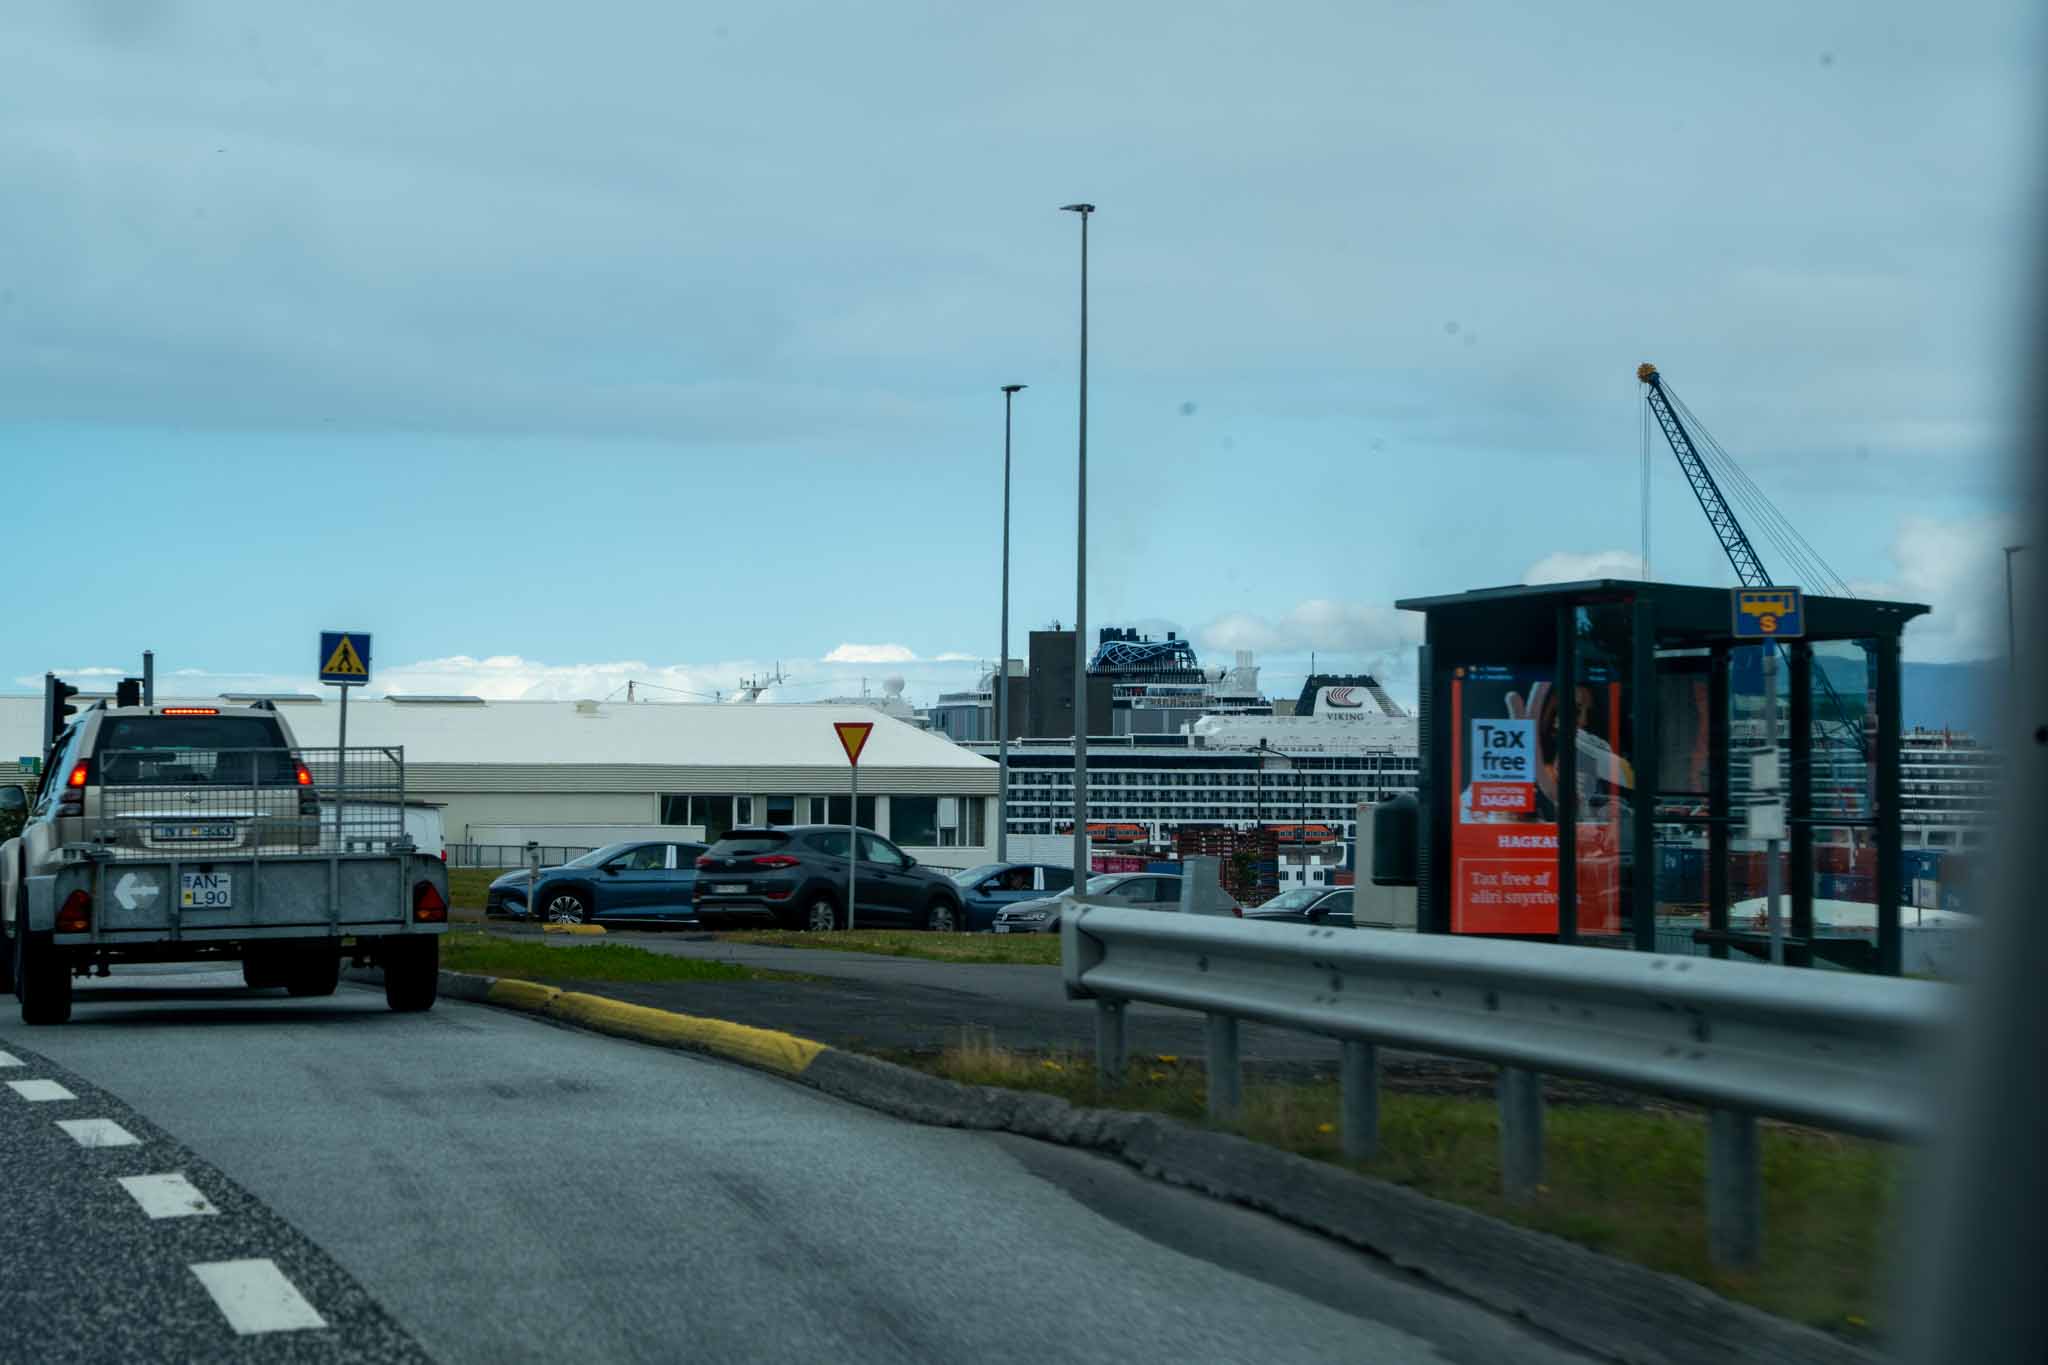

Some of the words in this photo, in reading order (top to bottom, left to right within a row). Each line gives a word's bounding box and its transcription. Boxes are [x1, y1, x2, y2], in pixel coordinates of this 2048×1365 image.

[1760, 615, 1777, 632] S
[1327, 712, 1364, 721] VIKING
[1478, 725, 1525, 748] Tax
[1482, 751, 1526, 770] free
[1471, 872, 1497, 885] Tax
[1502, 871, 1531, 885] free
[192, 891, 228, 905] L90
